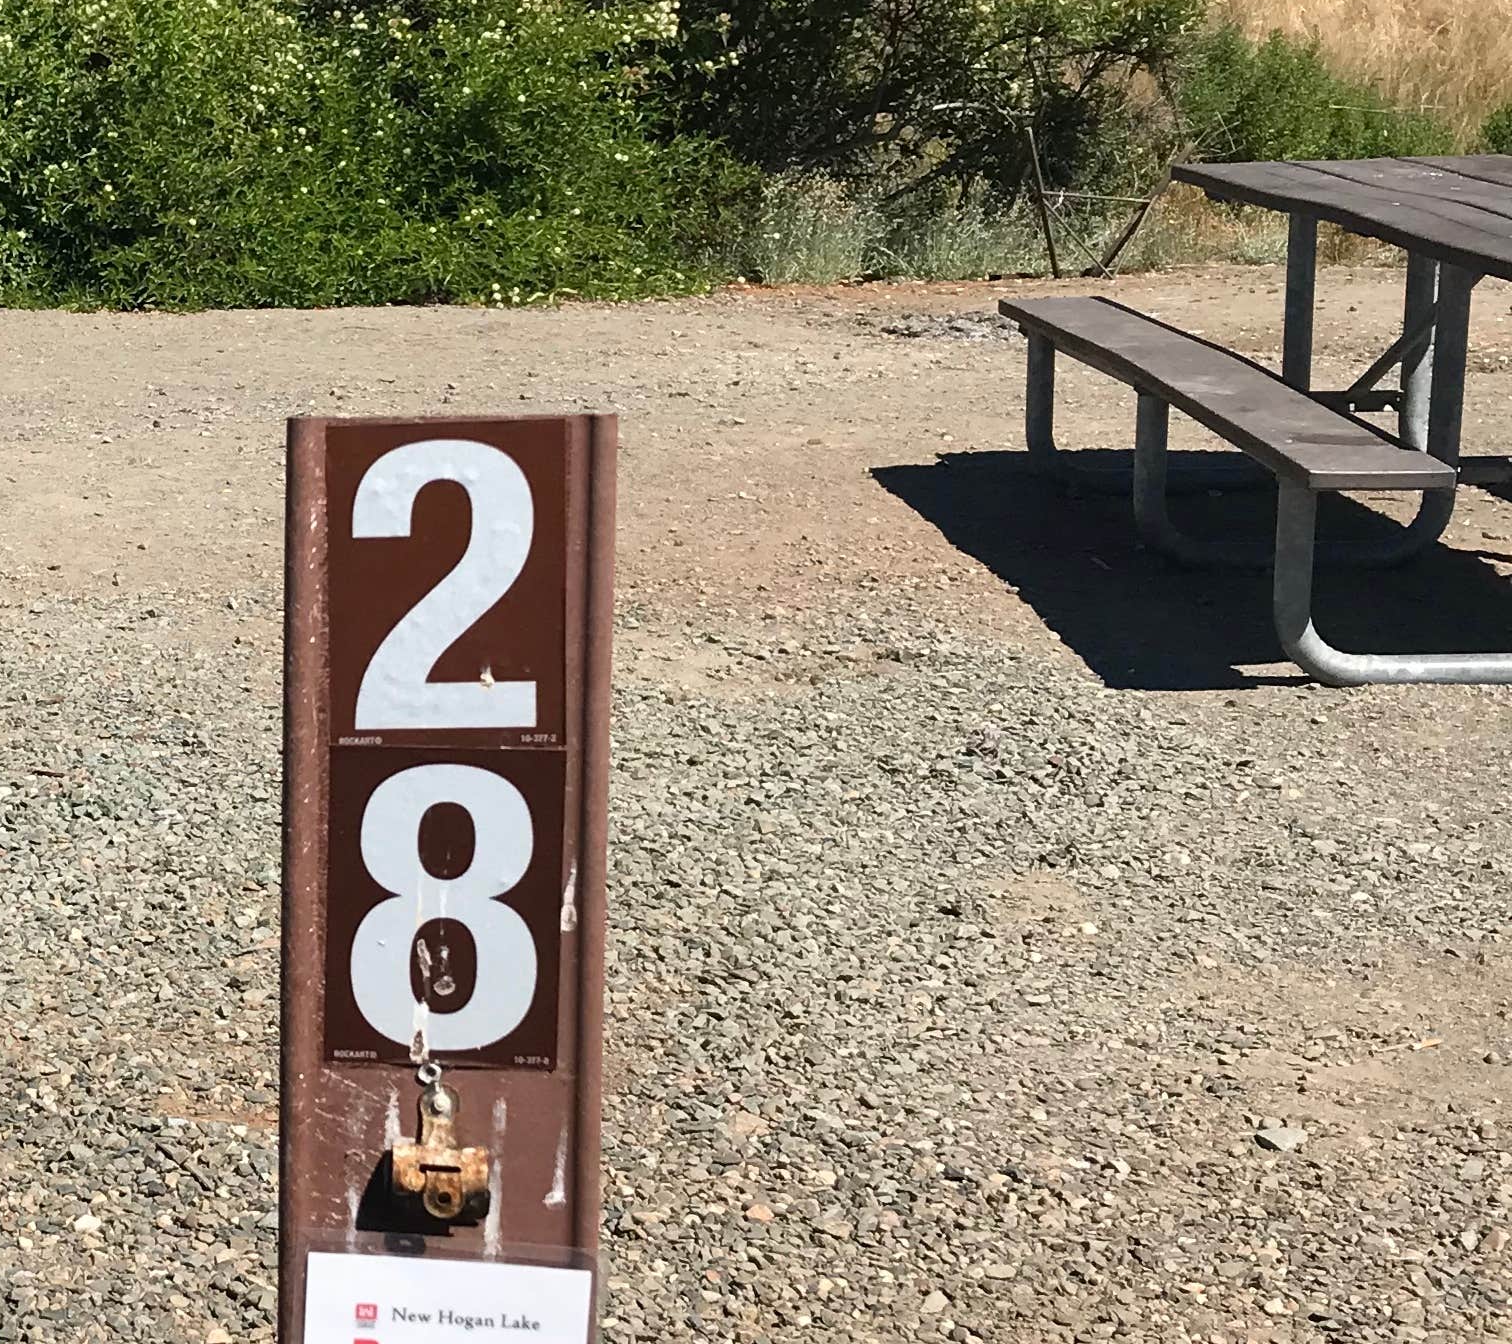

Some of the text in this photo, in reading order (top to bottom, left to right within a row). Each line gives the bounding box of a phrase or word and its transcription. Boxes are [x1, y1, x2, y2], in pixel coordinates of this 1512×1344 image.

[392, 1307, 541, 1331] New Hogan Lake
